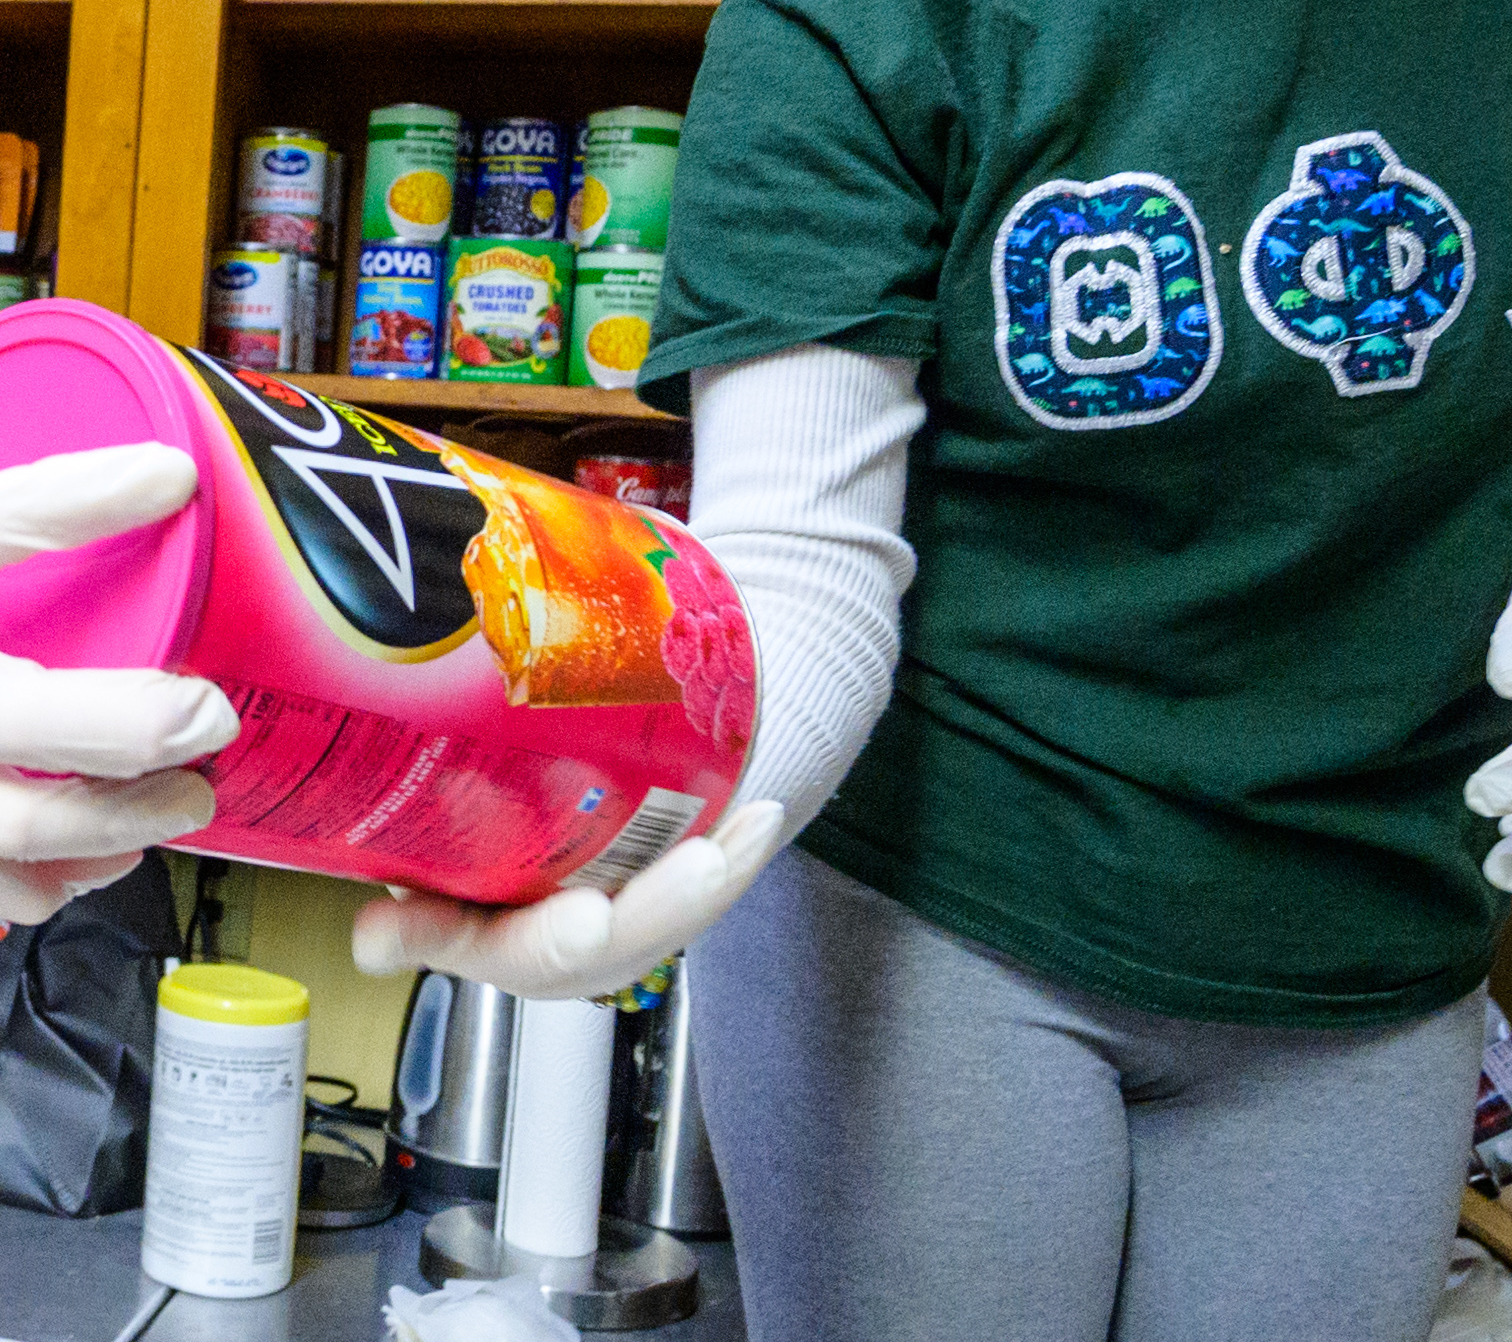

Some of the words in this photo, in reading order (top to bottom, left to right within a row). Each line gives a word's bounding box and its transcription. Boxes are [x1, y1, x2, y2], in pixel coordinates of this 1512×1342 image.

[481, 128, 557, 155] GOYA
[360, 250, 433, 277] GOYA
[467, 284, 535, 301] CRUSHED
[472, 301, 527, 314] TOMATOES
